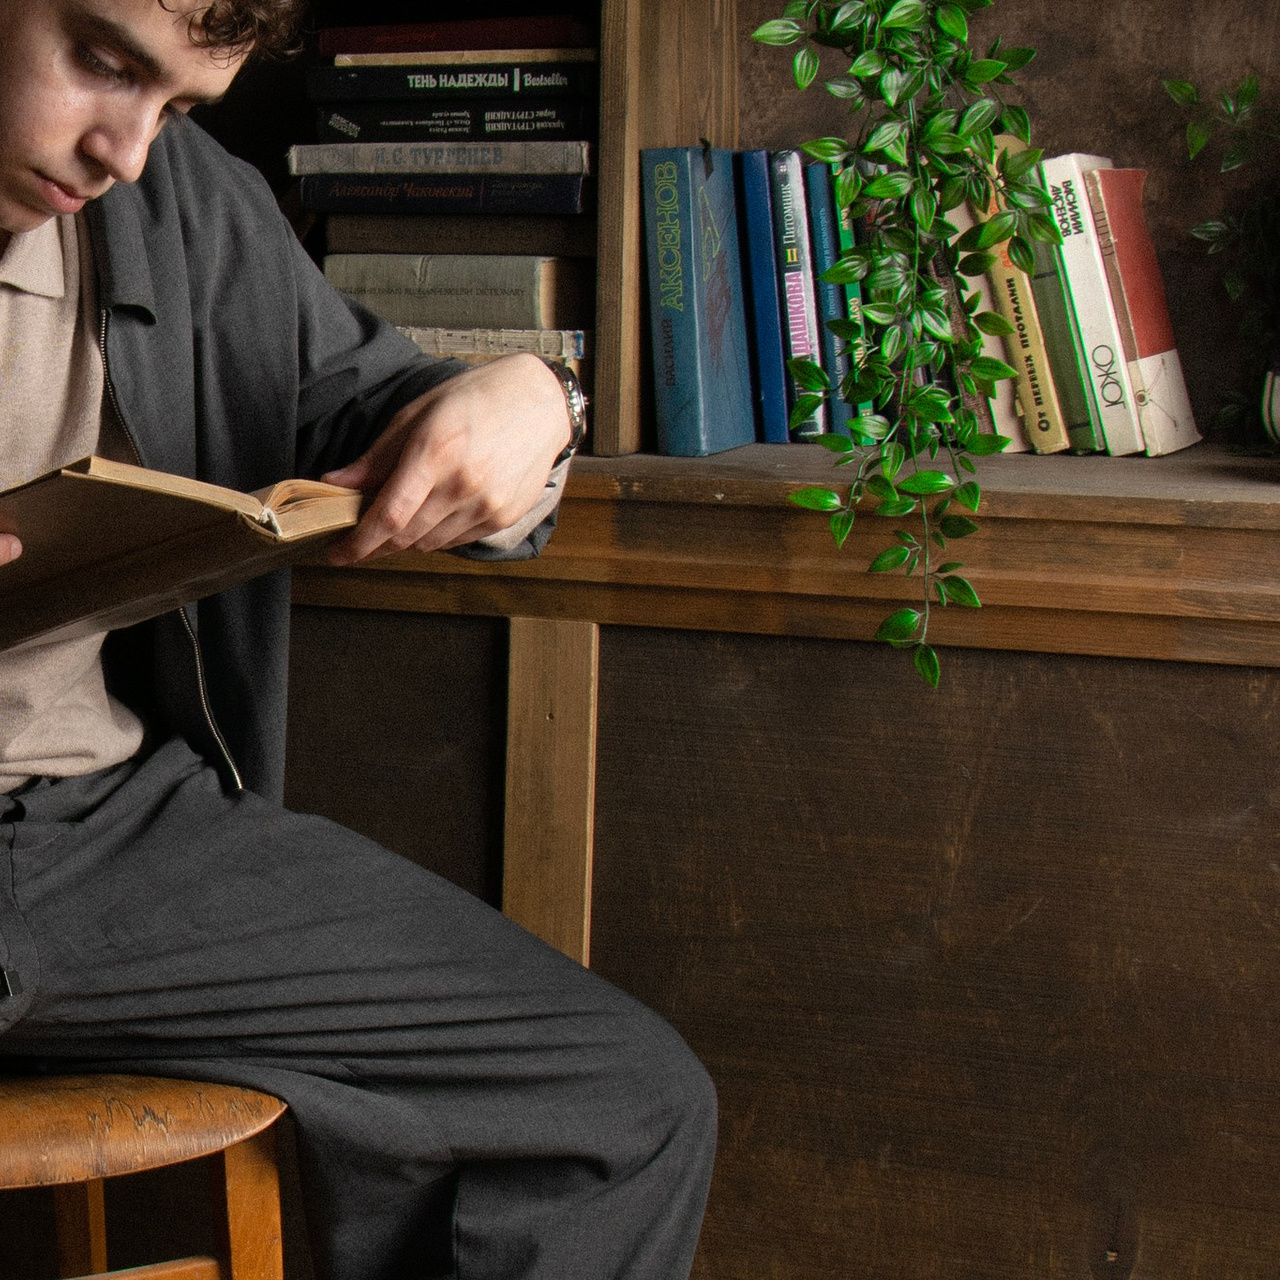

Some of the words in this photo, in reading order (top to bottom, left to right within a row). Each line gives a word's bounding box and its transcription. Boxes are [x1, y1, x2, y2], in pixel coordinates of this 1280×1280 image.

[406, 74, 436, 89] ТЕНЬ
[438, 72, 509, 90] НАДЕЖДЫ
[483, 109, 534, 121] СТРУГАЦКИЙ
[484, 121, 535, 133] СТРУГАЦКИЙ
[409, 145, 504, 166] ТУРГЕНЕВ
[328, 181, 400, 201] Александр
[779, 182, 796, 244] Питомник
[1050, 185, 1071, 236] АКСЕНОВ
[1064, 180, 1084, 235] ВАСИЛИЙ
[653, 160, 683, 311] АКСЕНОВ
[784, 271, 808, 356] ДАШКОВА
[660, 318, 676, 386] ВАСИЛИЙ
[1092, 344, 1126, 408] ОЖОГ
